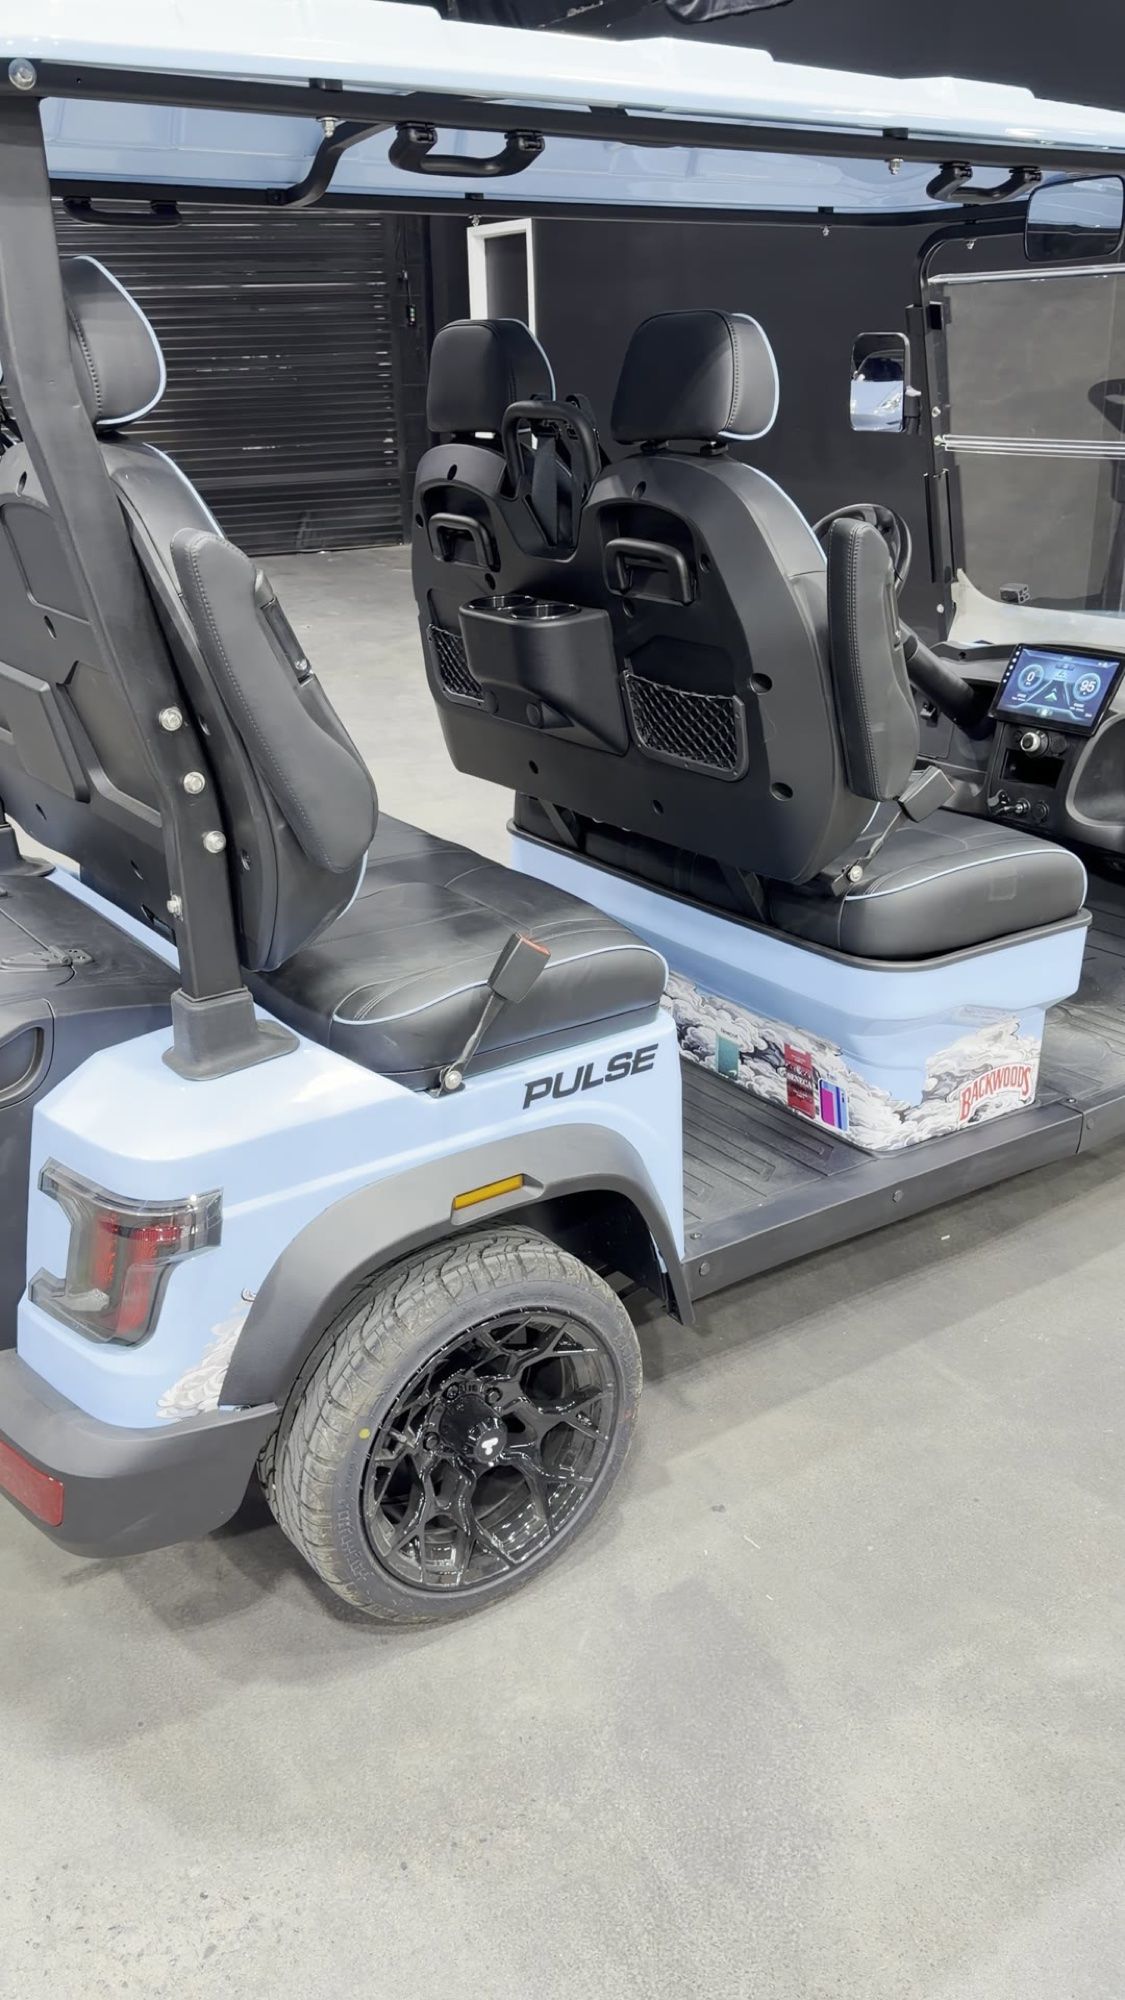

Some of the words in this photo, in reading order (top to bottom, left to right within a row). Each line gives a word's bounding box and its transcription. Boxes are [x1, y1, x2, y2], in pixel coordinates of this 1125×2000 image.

[1079, 679, 1097, 693] 95
[522, 1043, 659, 1110] PULSE
[959, 1065, 1032, 1121] BACKWOODS
